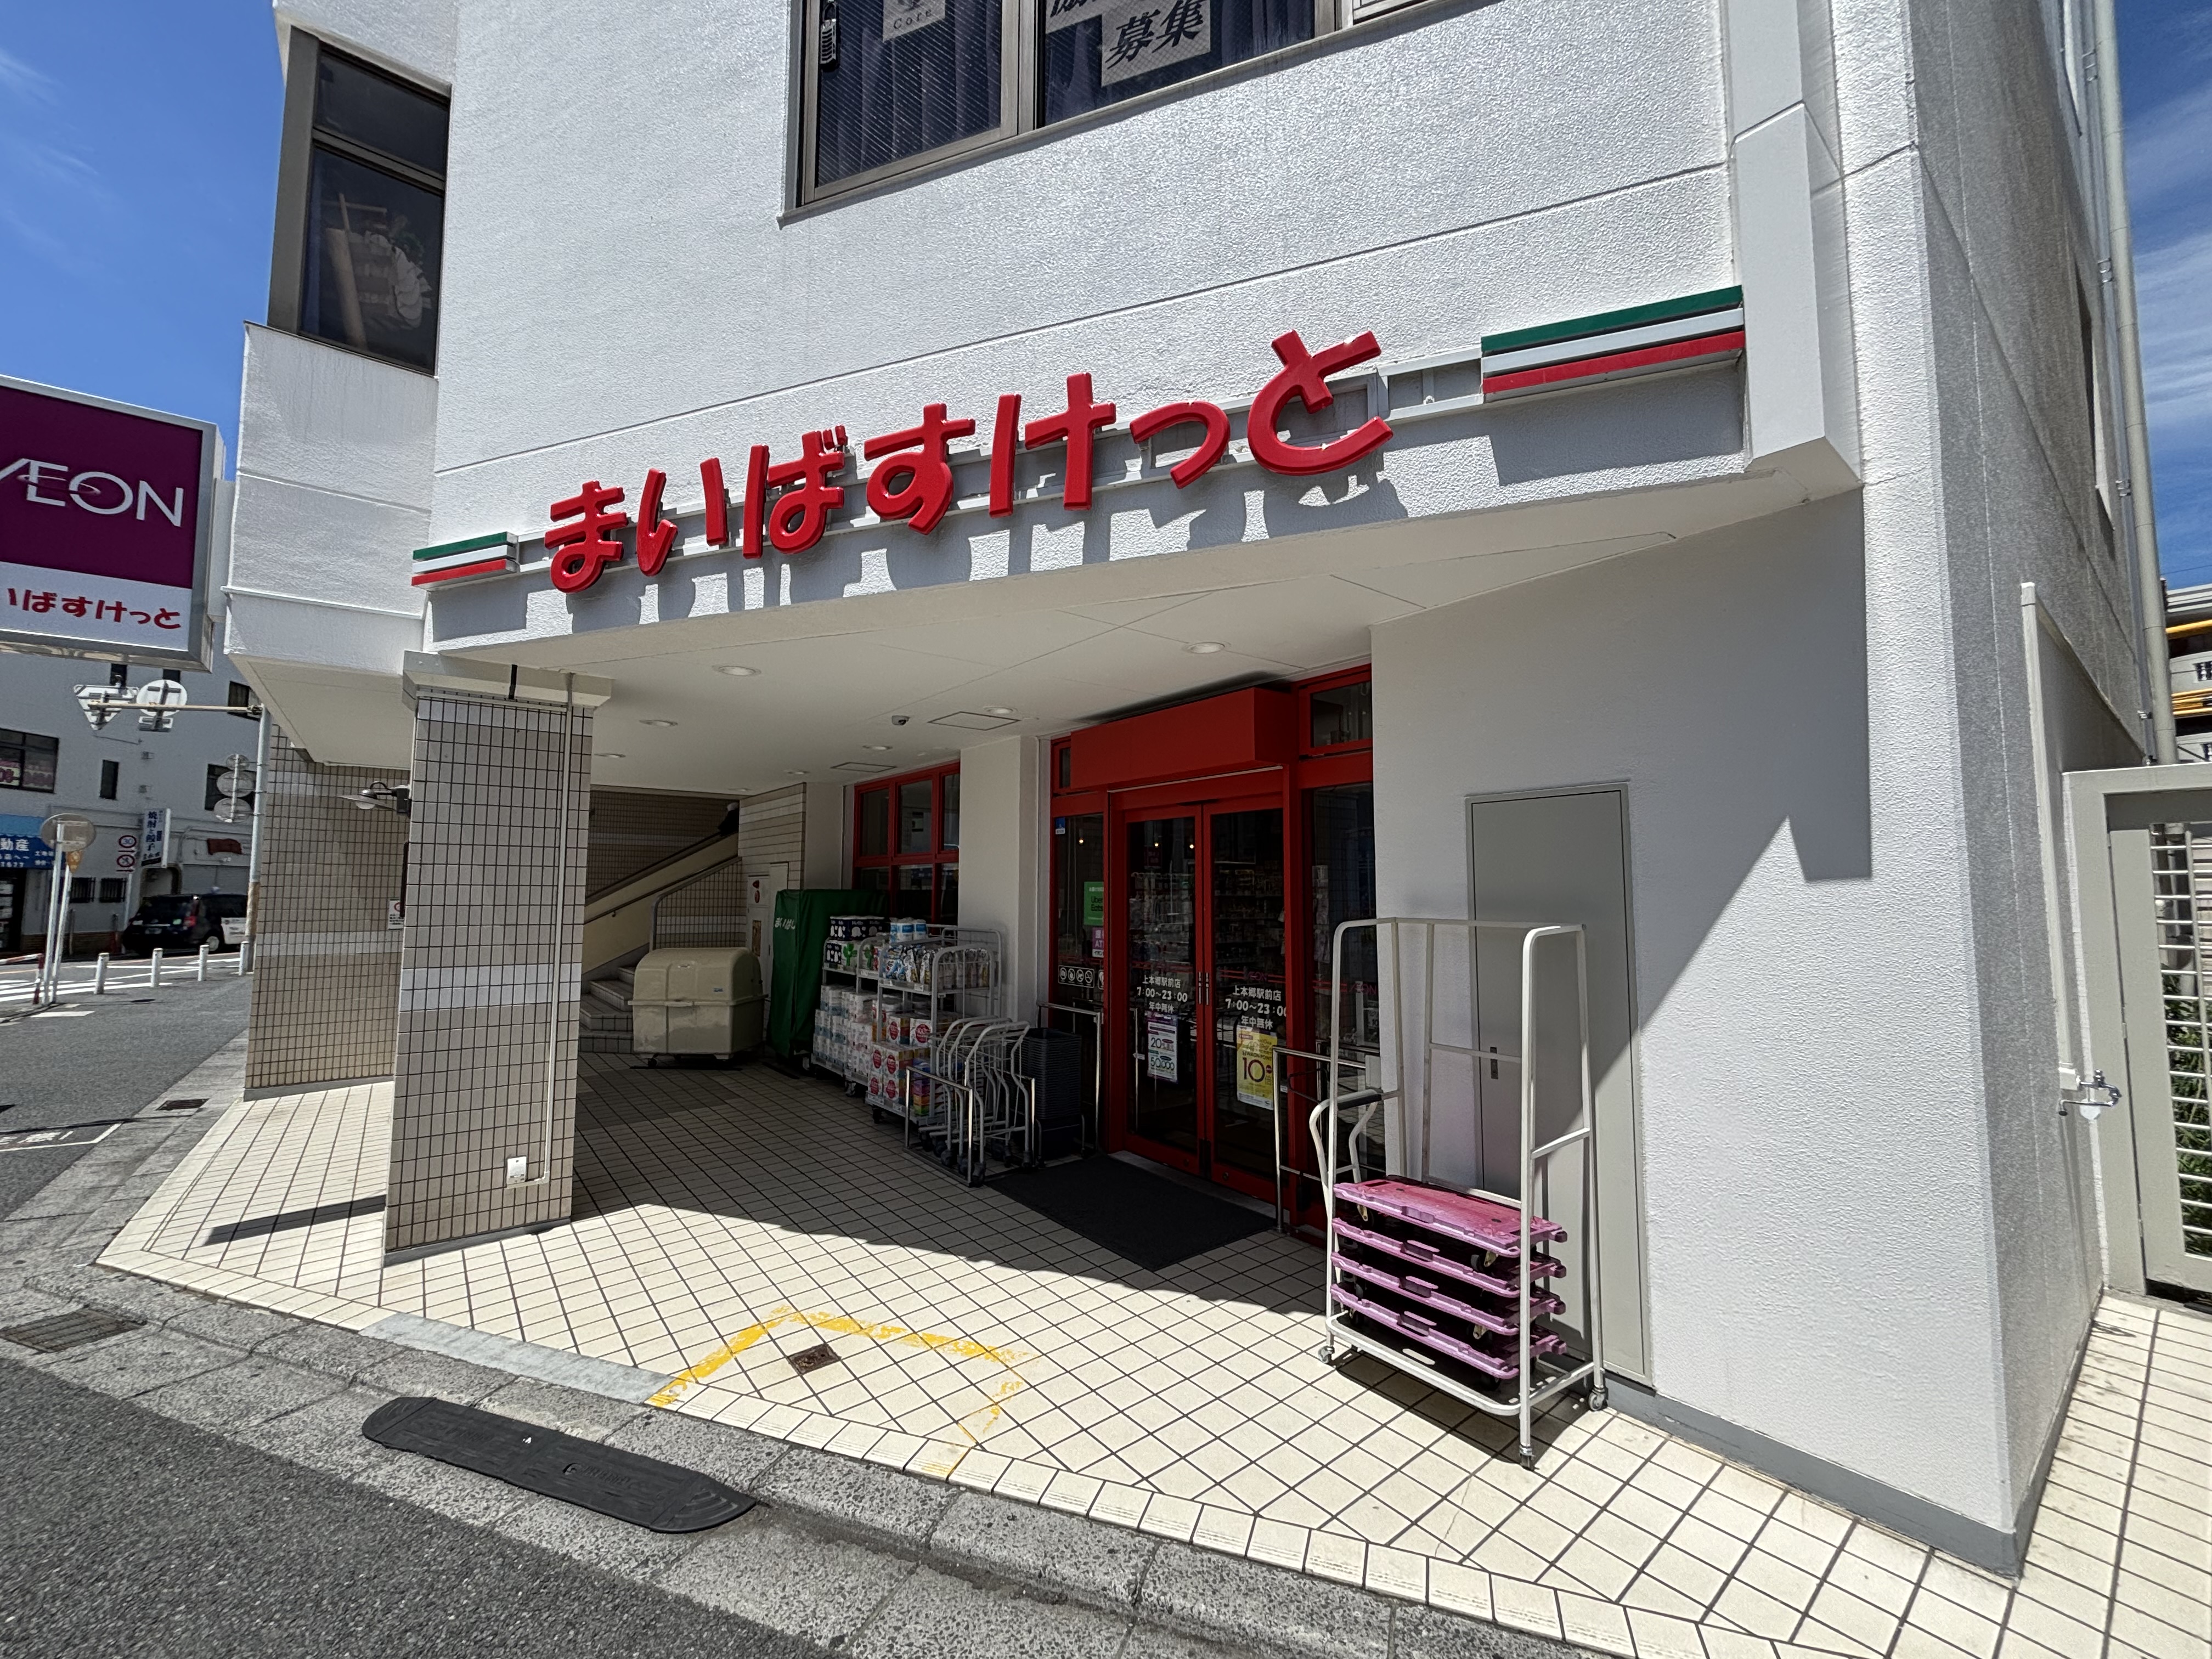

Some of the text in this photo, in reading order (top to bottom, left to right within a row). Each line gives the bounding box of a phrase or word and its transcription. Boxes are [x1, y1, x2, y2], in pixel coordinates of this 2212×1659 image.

[893, 8, 933, 30] Core
[1105, 0, 1204, 70] 募集
[543, 329, 1395, 595] まいばすけっと
[0, 458, 184, 527] AEON
[0, 838, 30, 851] 動産
[1142, 974, 1181, 989] 上本郷駅前店
[1232, 984, 1282, 1002] 上本郷駅前店
[1148, 1001, 1175, 1014] 年中無休
[1240, 1014, 1273, 1031] 年中無休
[1150, 1037, 1162, 1048] 20
